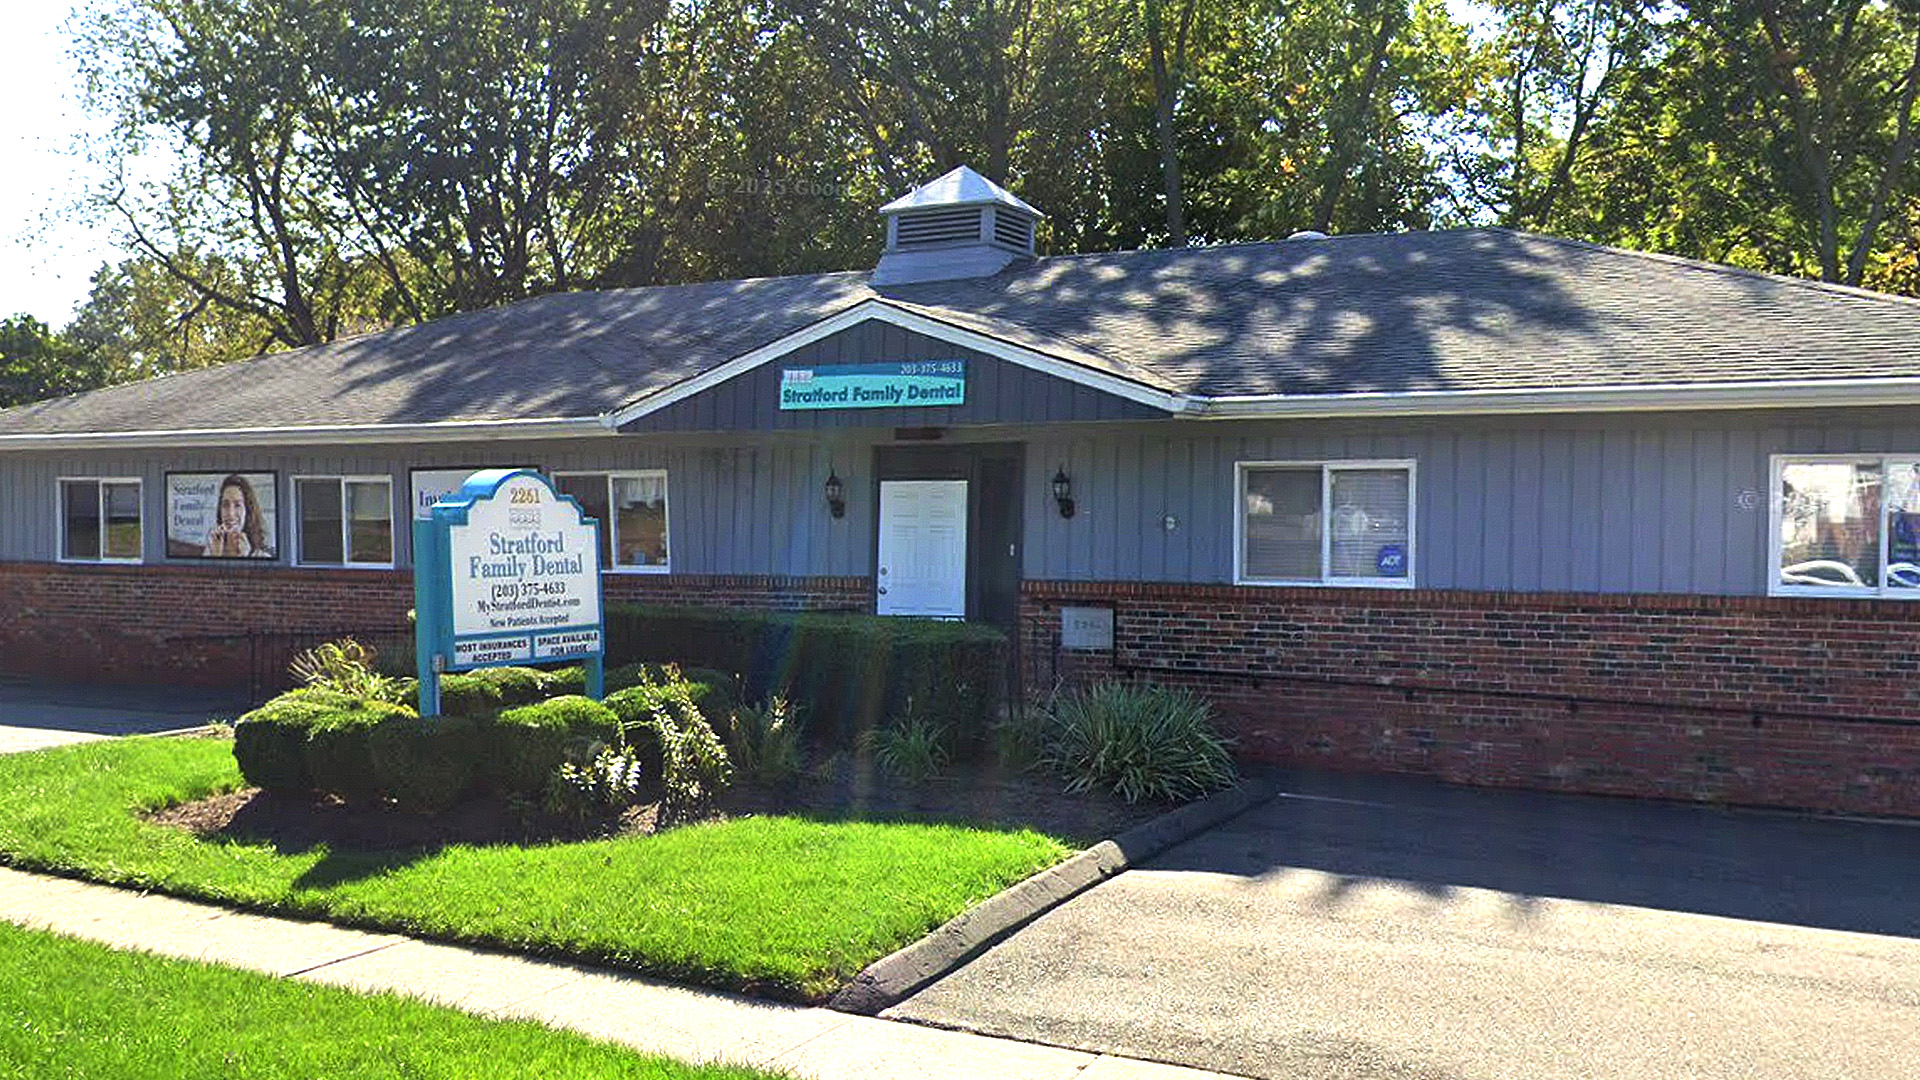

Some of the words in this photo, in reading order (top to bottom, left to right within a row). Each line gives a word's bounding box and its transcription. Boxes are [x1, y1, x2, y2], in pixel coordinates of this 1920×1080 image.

[784, 388, 848, 403] Stratford
[853, 385, 904, 402] Family
[908, 383, 960, 399] Dental
[489, 531, 564, 555] Stratford
[469, 554, 526, 582] Family
[532, 553, 582, 576] Dental
[491, 583, 518, 601] (203)
[520, 581, 565, 596] 375-4633
[507, 616, 538, 627] Patients
[540, 614, 569, 626] Accepted
[456, 643, 477, 653] MOST
[479, 639, 527, 651] INSURANCES
[537, 636, 561, 646] SPACE
[562, 632, 598, 643] AVAILABLE
[472, 651, 512, 662] ACCEPTED
[550, 646, 565, 656] FOR
[566, 644, 588, 654] LEASE
